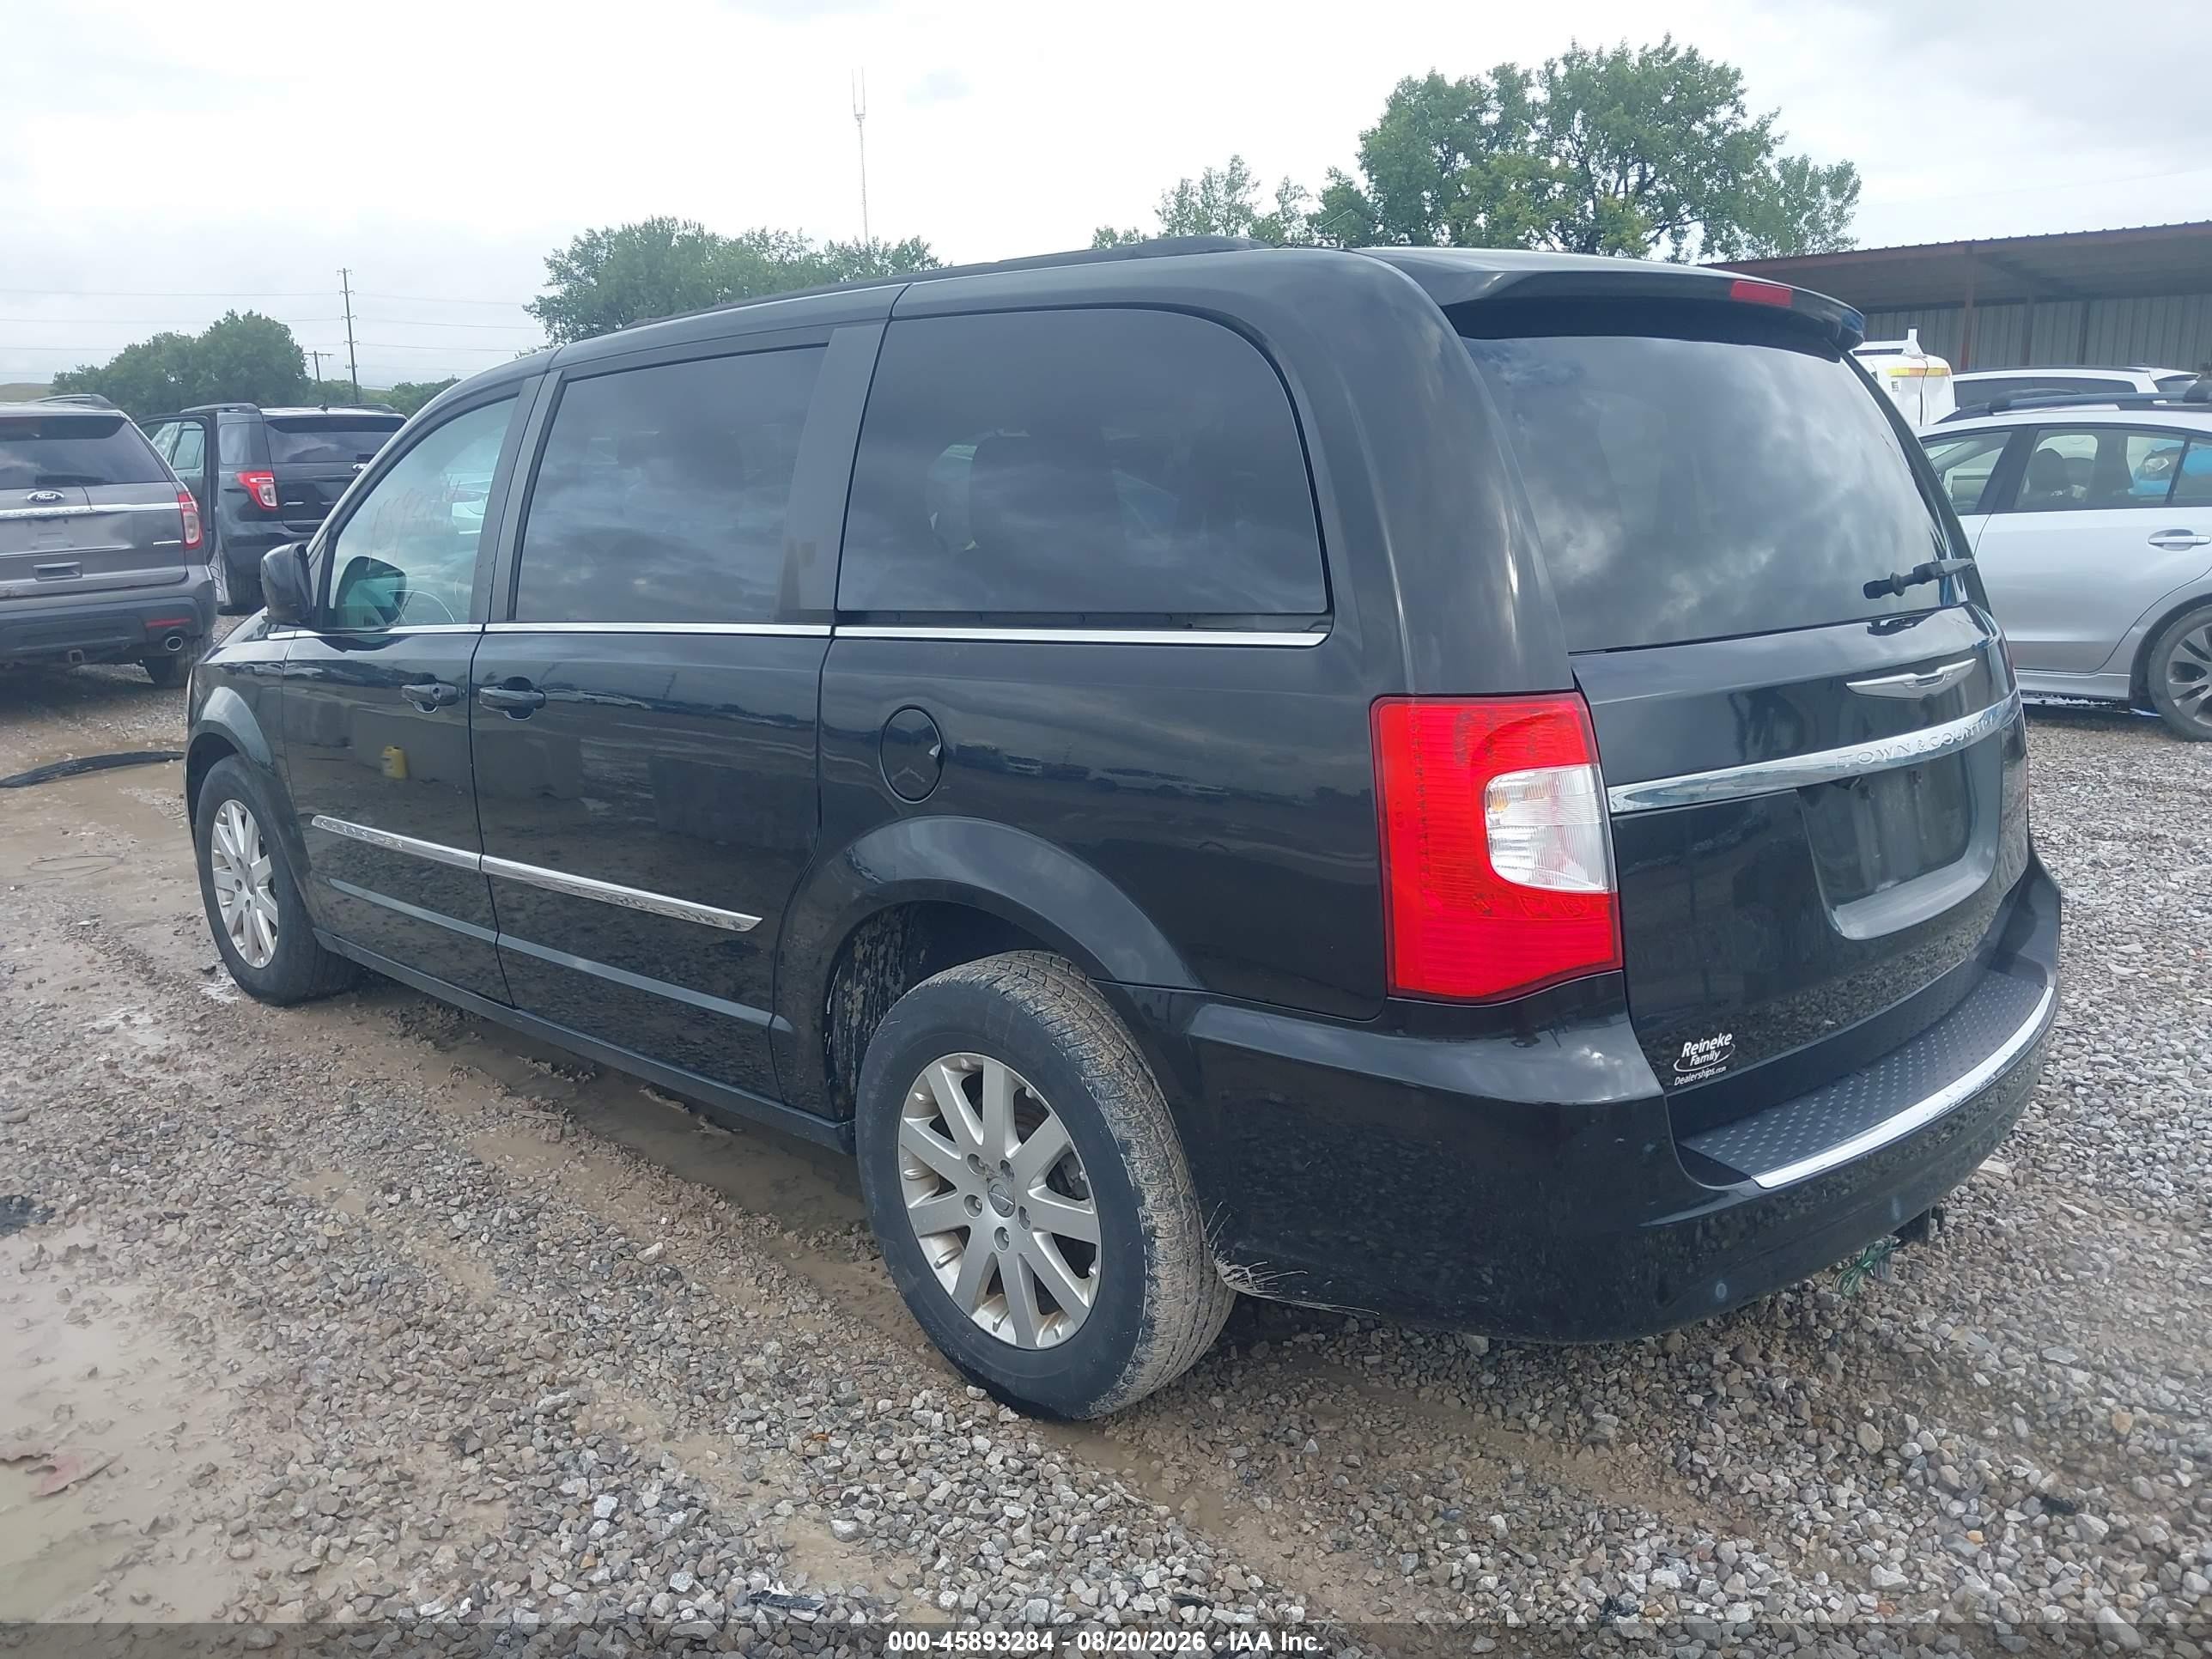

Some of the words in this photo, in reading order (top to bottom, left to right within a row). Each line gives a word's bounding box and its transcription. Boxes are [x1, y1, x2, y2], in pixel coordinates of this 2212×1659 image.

[1835, 743, 1911, 769] TOWN
[1917, 739, 1929, 751] &
[1681, 1033, 1733, 1058] Reineke
[1689, 1050, 1721, 1066] Family
